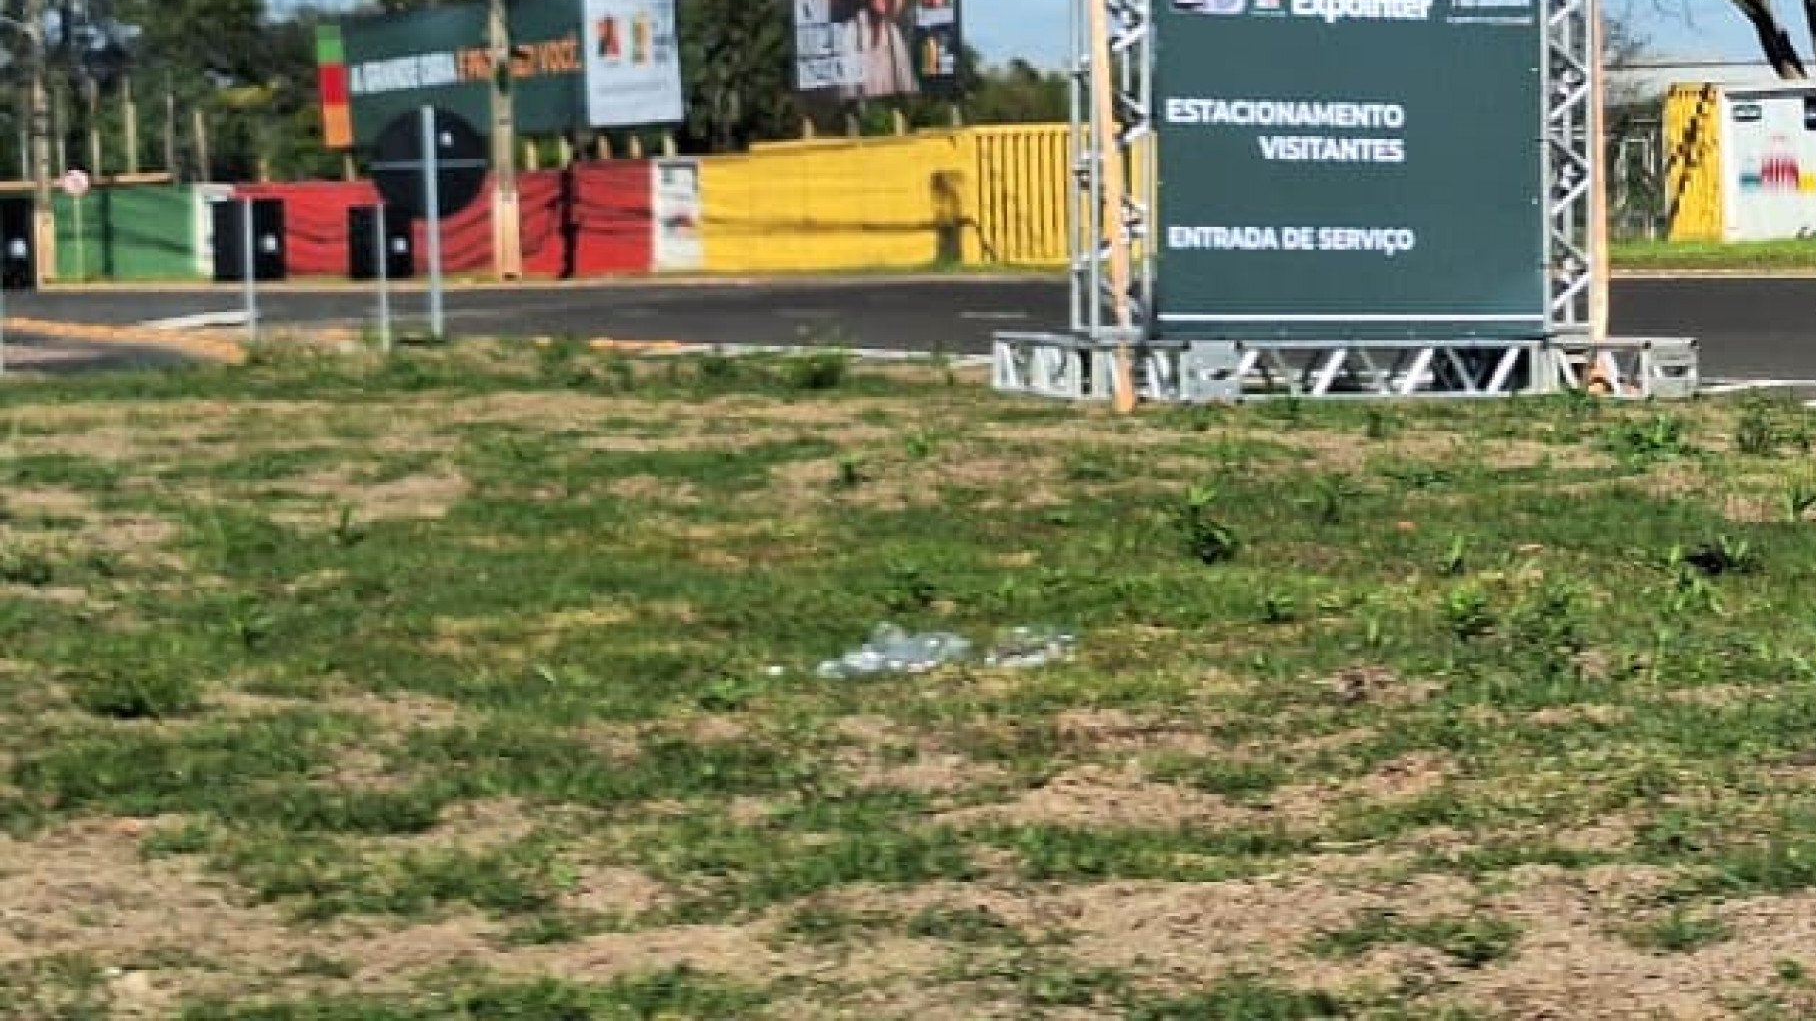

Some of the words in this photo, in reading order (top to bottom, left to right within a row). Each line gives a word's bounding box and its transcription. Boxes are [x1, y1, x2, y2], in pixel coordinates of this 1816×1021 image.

[1165, 98, 1405, 128] ESTACIONAMENTO
[1256, 135, 1405, 163] VISITANTES
[1168, 226, 1279, 250] ENTRADA
[1281, 227, 1315, 250] DE
[1317, 227, 1416, 256] SERVIÇO
